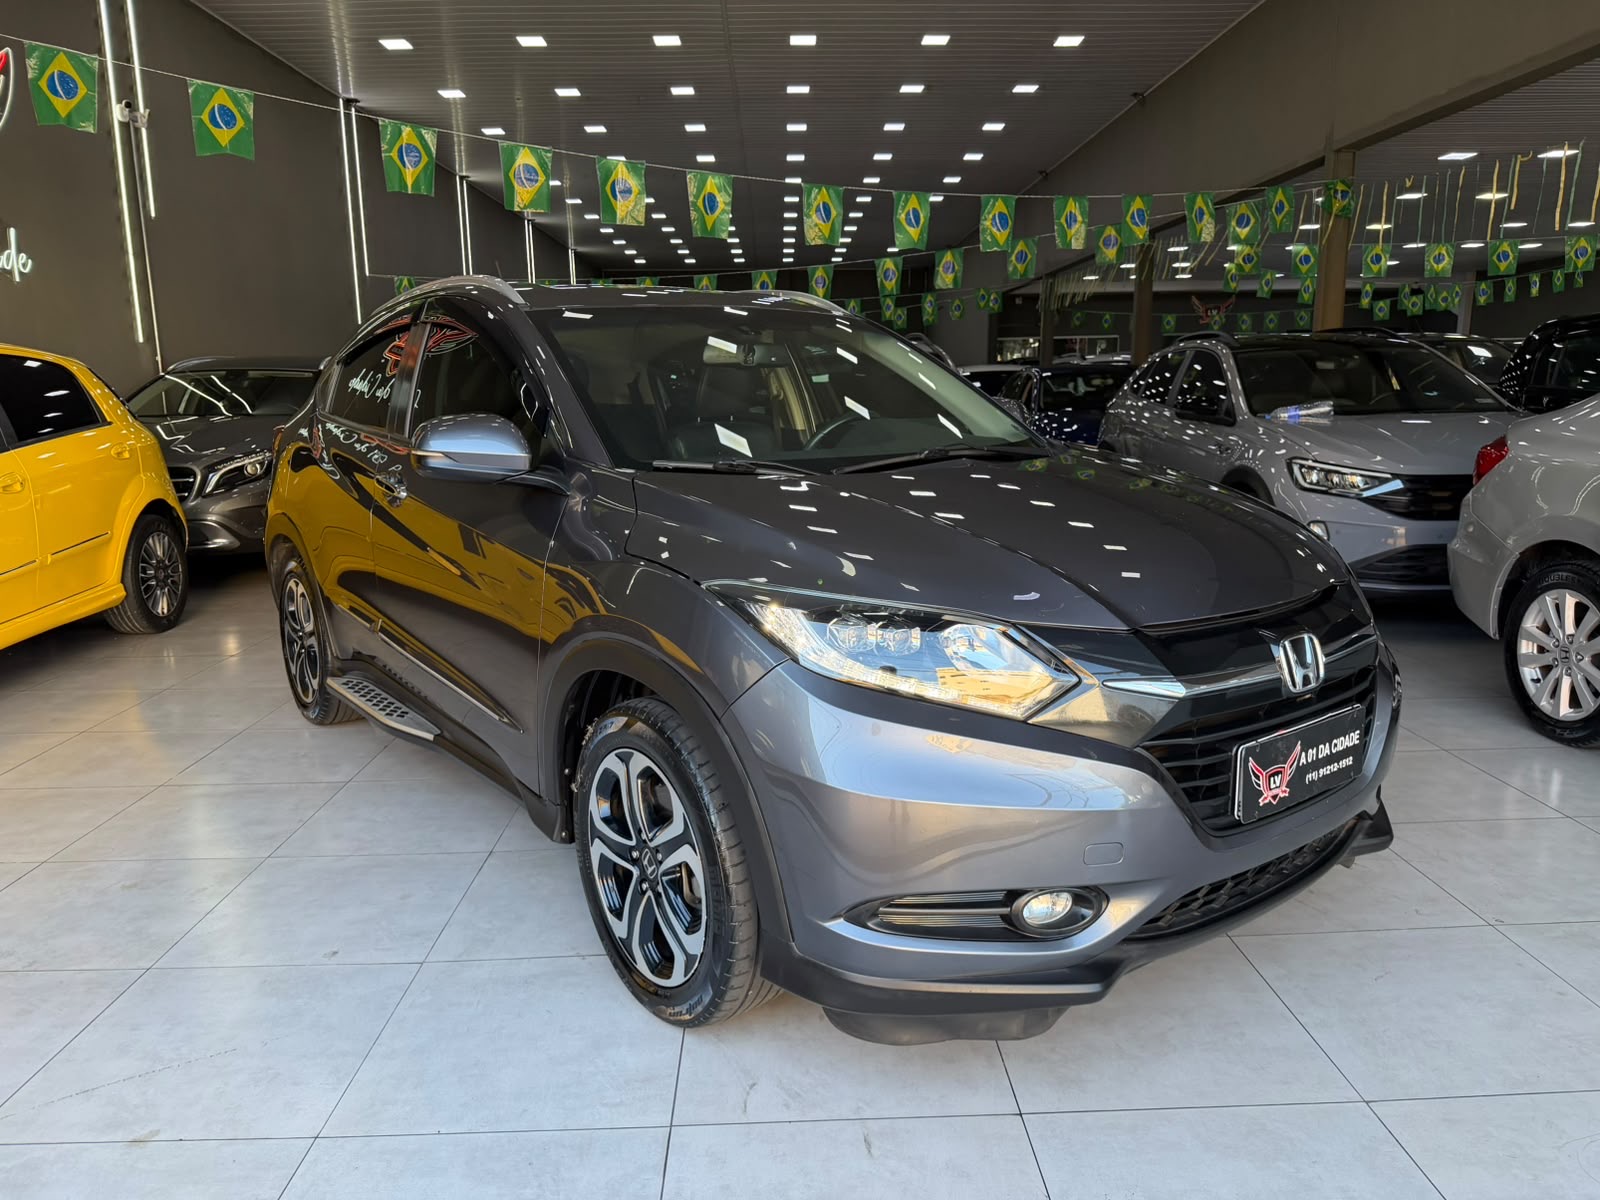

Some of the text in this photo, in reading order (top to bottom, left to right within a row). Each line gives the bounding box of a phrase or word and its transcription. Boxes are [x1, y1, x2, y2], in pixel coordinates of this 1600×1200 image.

[1299, 729, 1361, 767] A 01 DA CIDADE
[1270, 773, 1282, 789] LV
[1305, 770, 1318, 785] (11)
